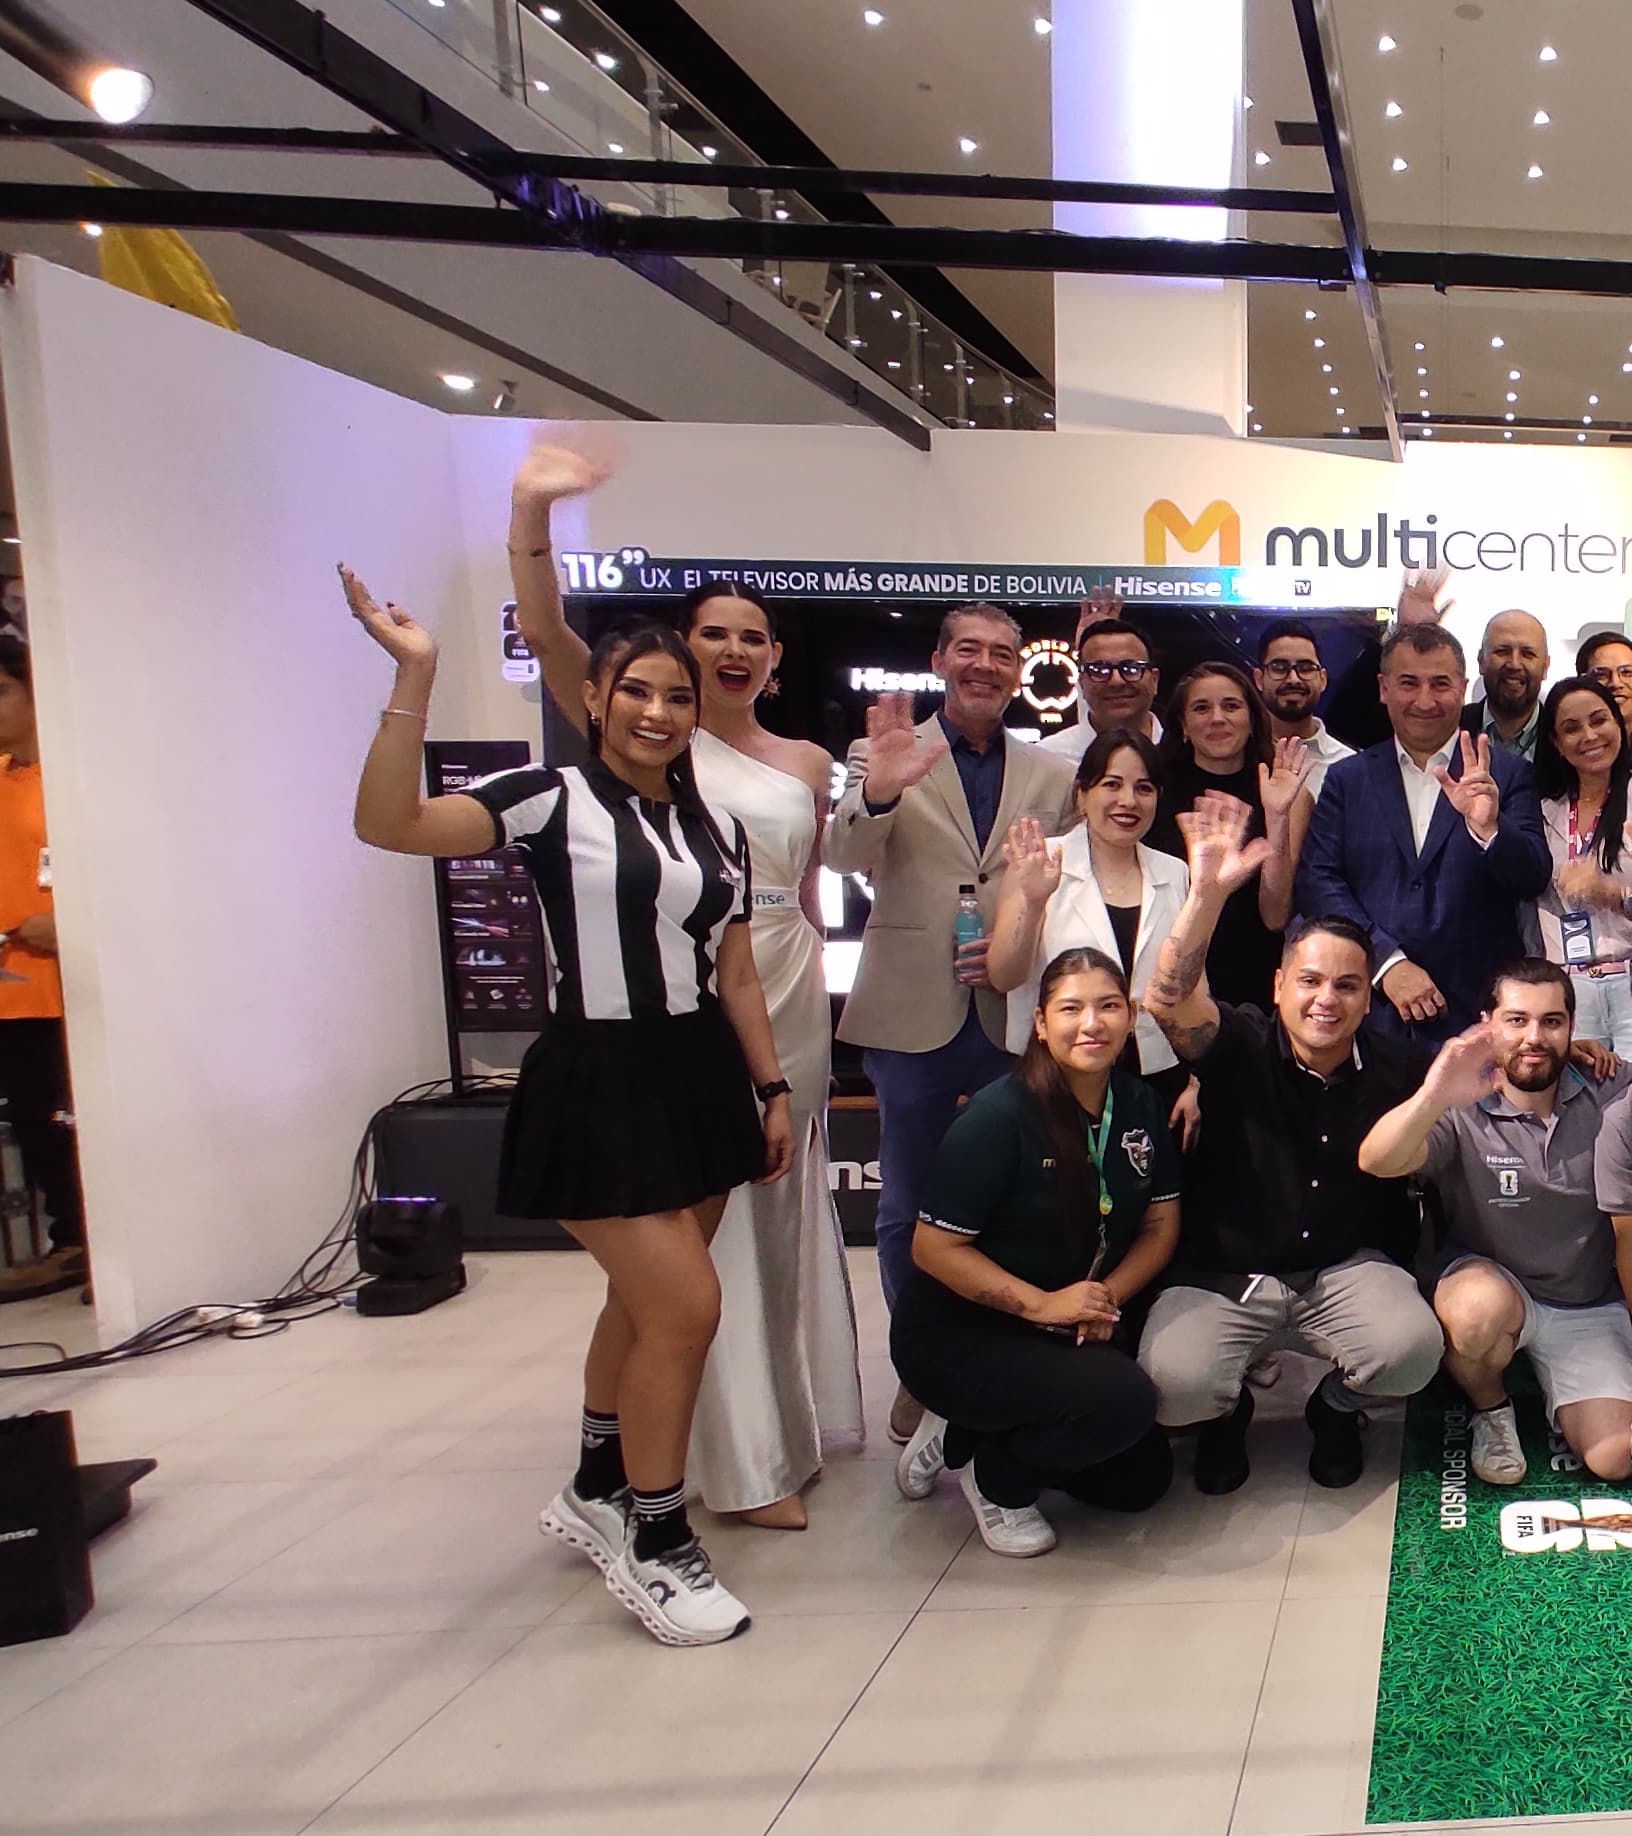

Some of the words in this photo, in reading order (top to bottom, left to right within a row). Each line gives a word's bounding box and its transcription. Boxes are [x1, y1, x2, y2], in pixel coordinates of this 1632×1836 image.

[640, 568, 672, 590] UX
[824, 568, 873, 592] MÁS
[877, 572, 969, 594] GRANDE
[974, 575, 1001, 594] DE
[1007, 576, 1087, 595] BOLIVIA
[1114, 575, 1222, 598] Hisense
[1440, 1449, 1468, 1530] SPONSOR
[1516, 1515, 1534, 1538] FIFA
